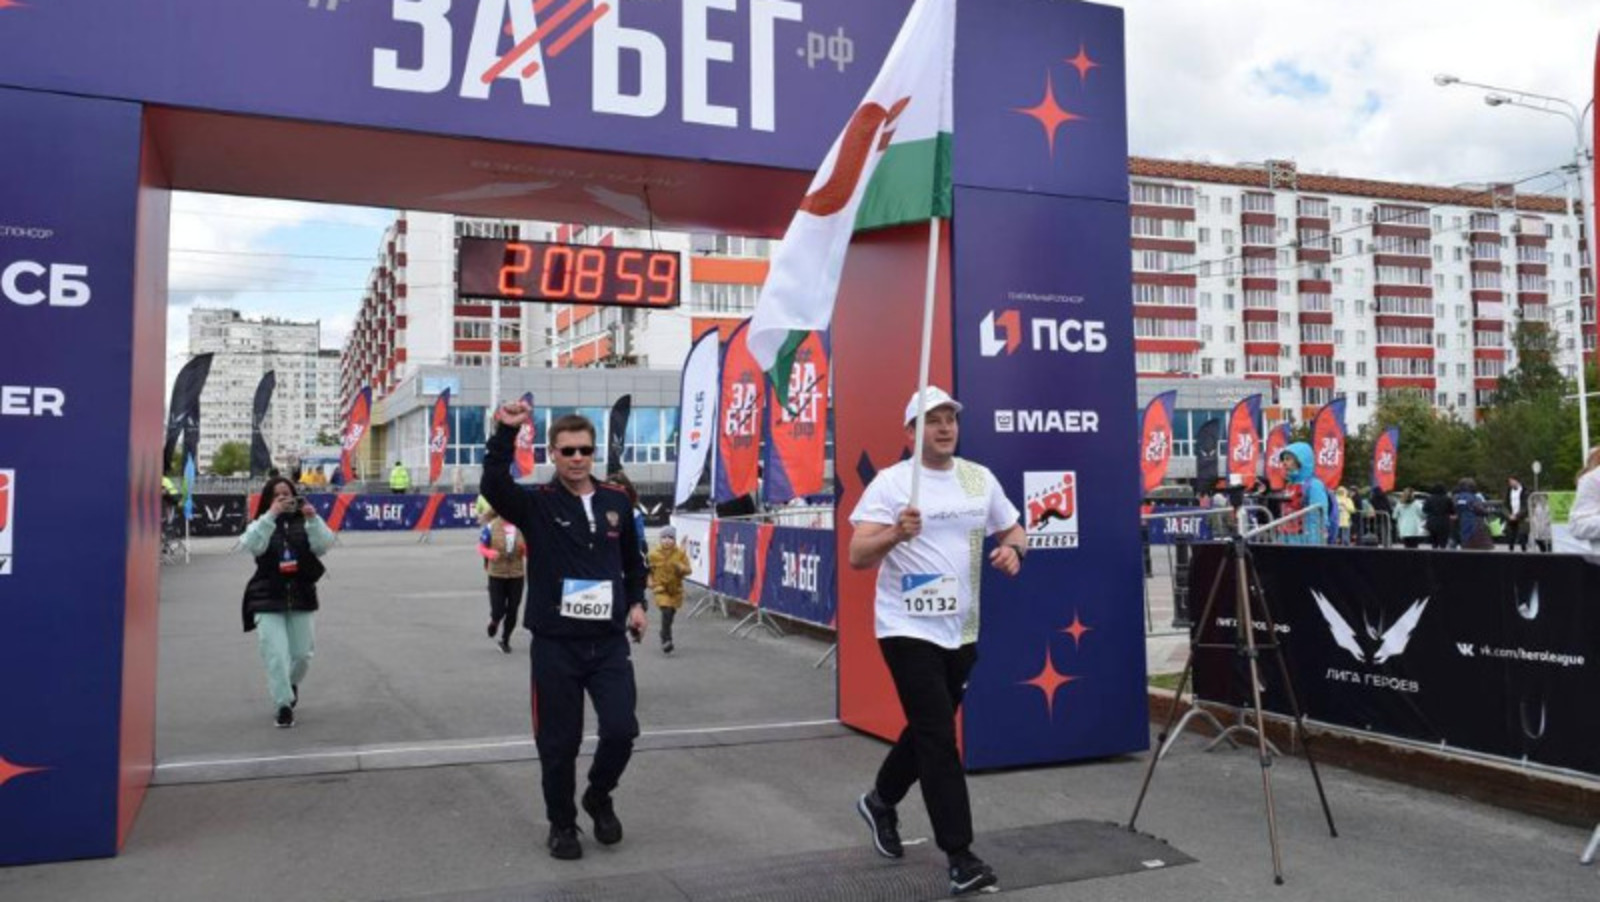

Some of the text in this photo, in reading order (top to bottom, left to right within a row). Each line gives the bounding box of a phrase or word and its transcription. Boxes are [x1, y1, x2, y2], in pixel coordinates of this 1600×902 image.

[1031, 317, 1108, 353] ПСБ
[1017, 409, 1099, 433] MAER
[1027, 535, 1076, 548] ENERGY
[564, 602, 610, 616] 10607
[904, 598, 957, 612] 10132
[1480, 645, 1585, 666] vk.com/heroleague
[1325, 667, 1420, 692] ЛИГА ГЕРОЕВ
